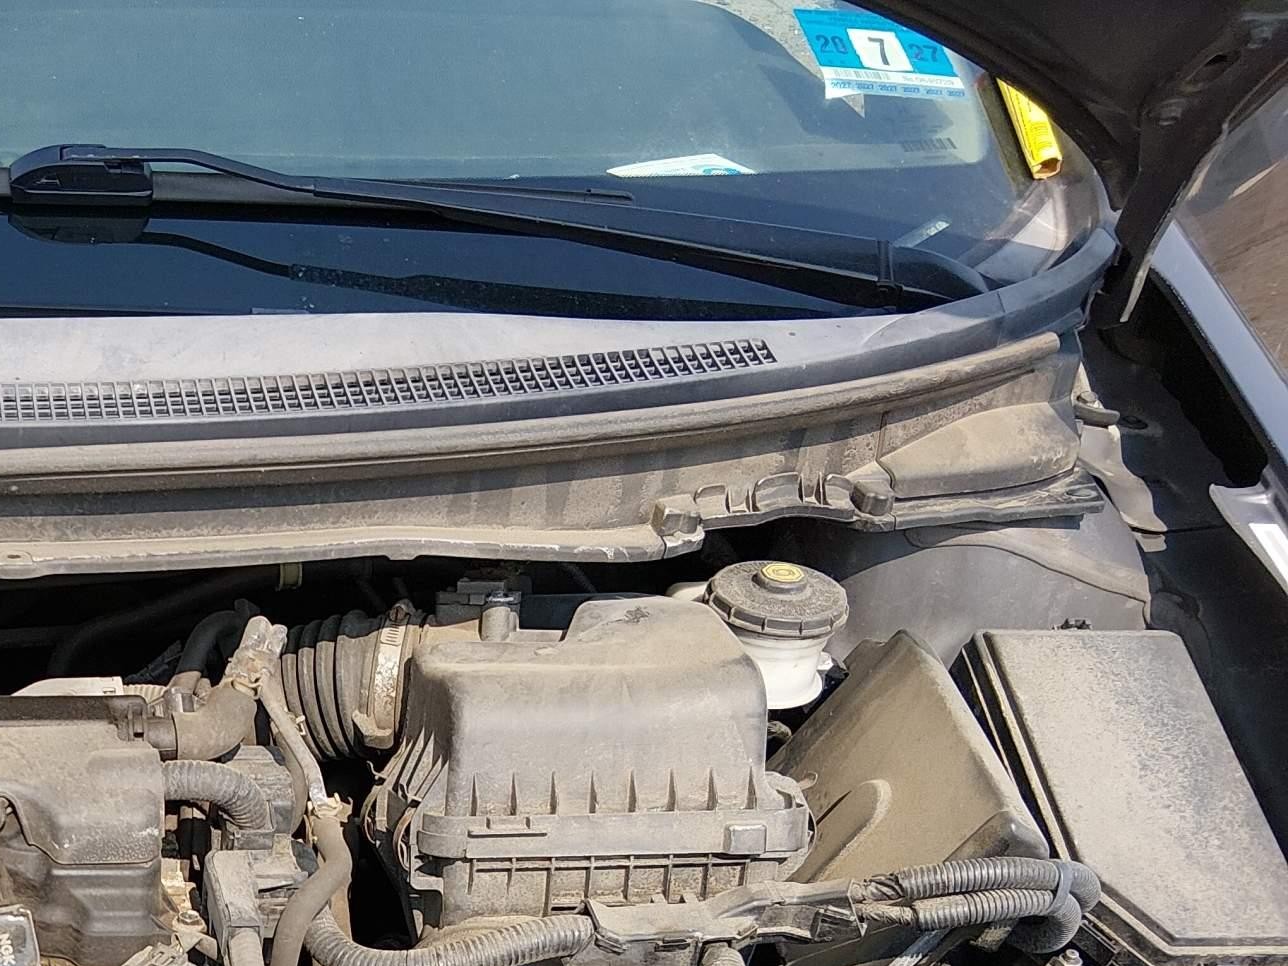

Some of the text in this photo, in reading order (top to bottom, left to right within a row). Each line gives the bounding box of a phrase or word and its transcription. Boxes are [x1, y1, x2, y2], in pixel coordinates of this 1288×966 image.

[815, 34, 939, 66] 20 7 27
